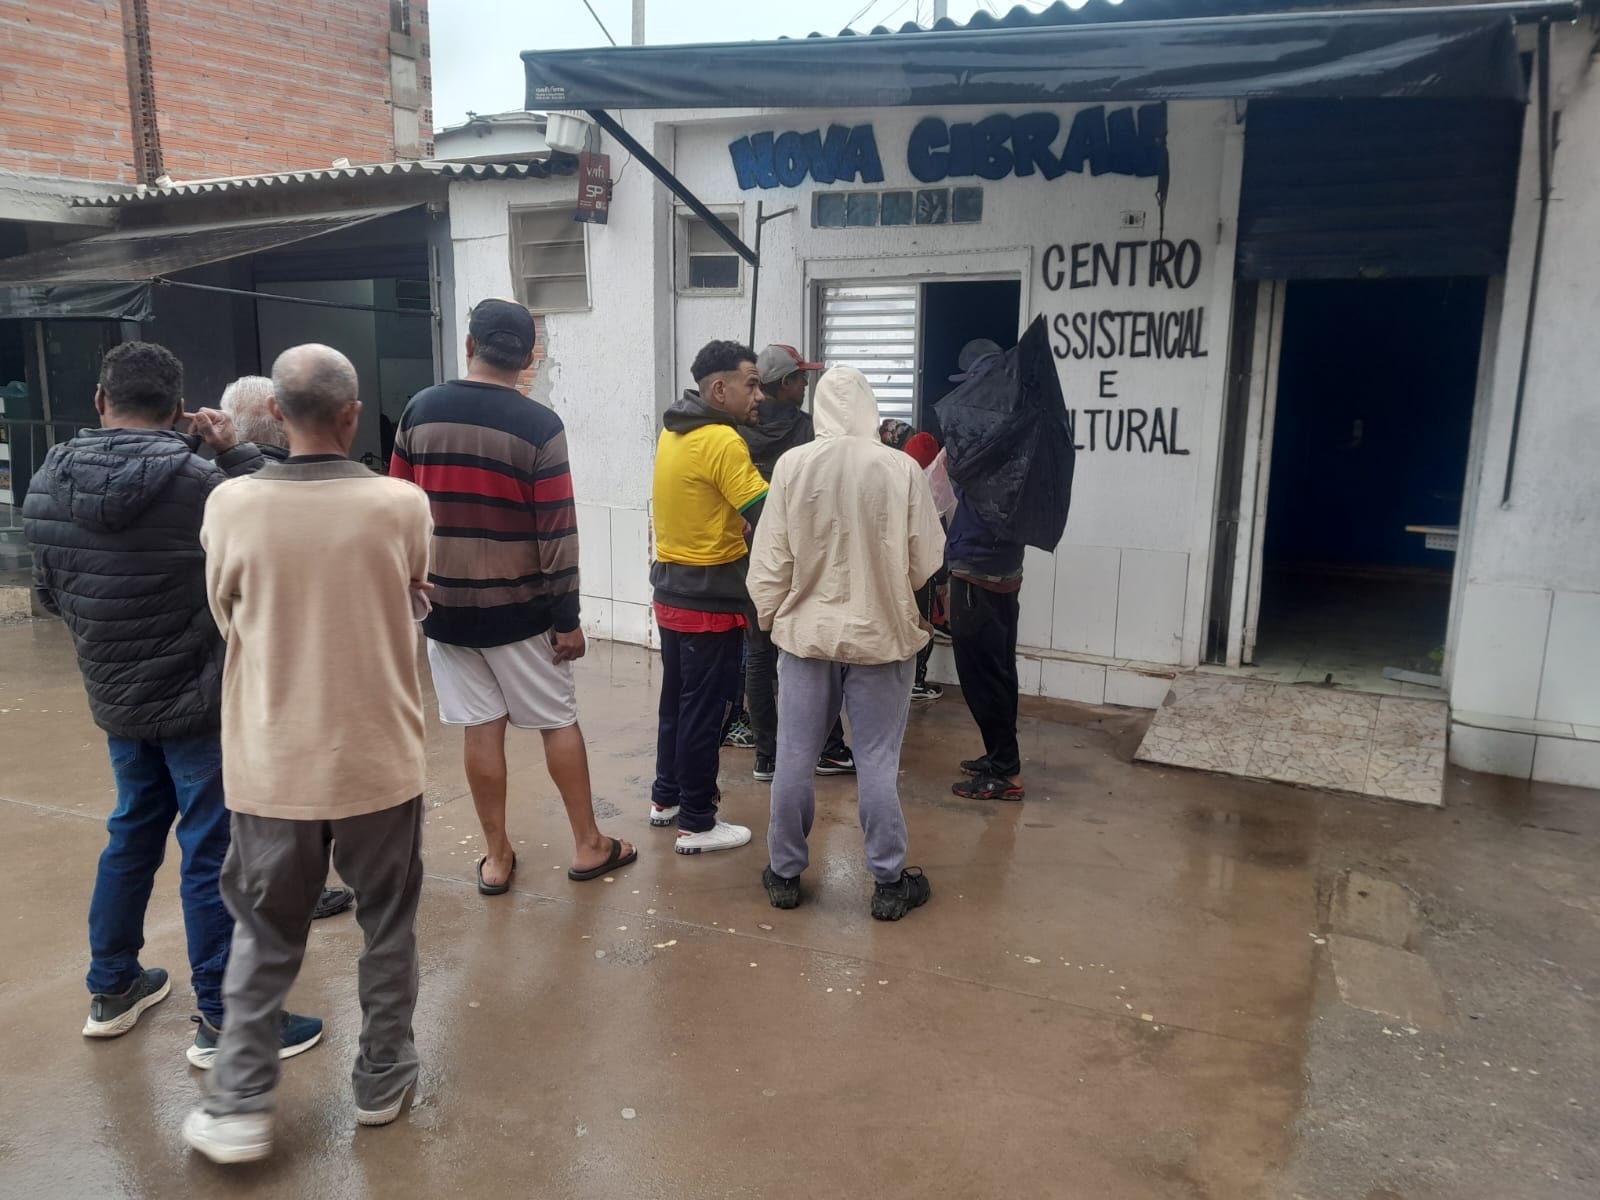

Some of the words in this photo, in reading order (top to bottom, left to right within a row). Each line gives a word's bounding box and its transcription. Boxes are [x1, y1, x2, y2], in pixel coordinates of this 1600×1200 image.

[729, 123, 884, 191] NOVA
[585, 184, 604, 198] SP
[1042, 238, 1202, 291] CENTRO
[1044, 306, 1209, 360] SSISTENCIAL
[1099, 370, 1119, 398] E
[1066, 406, 1190, 455] LTURAL
